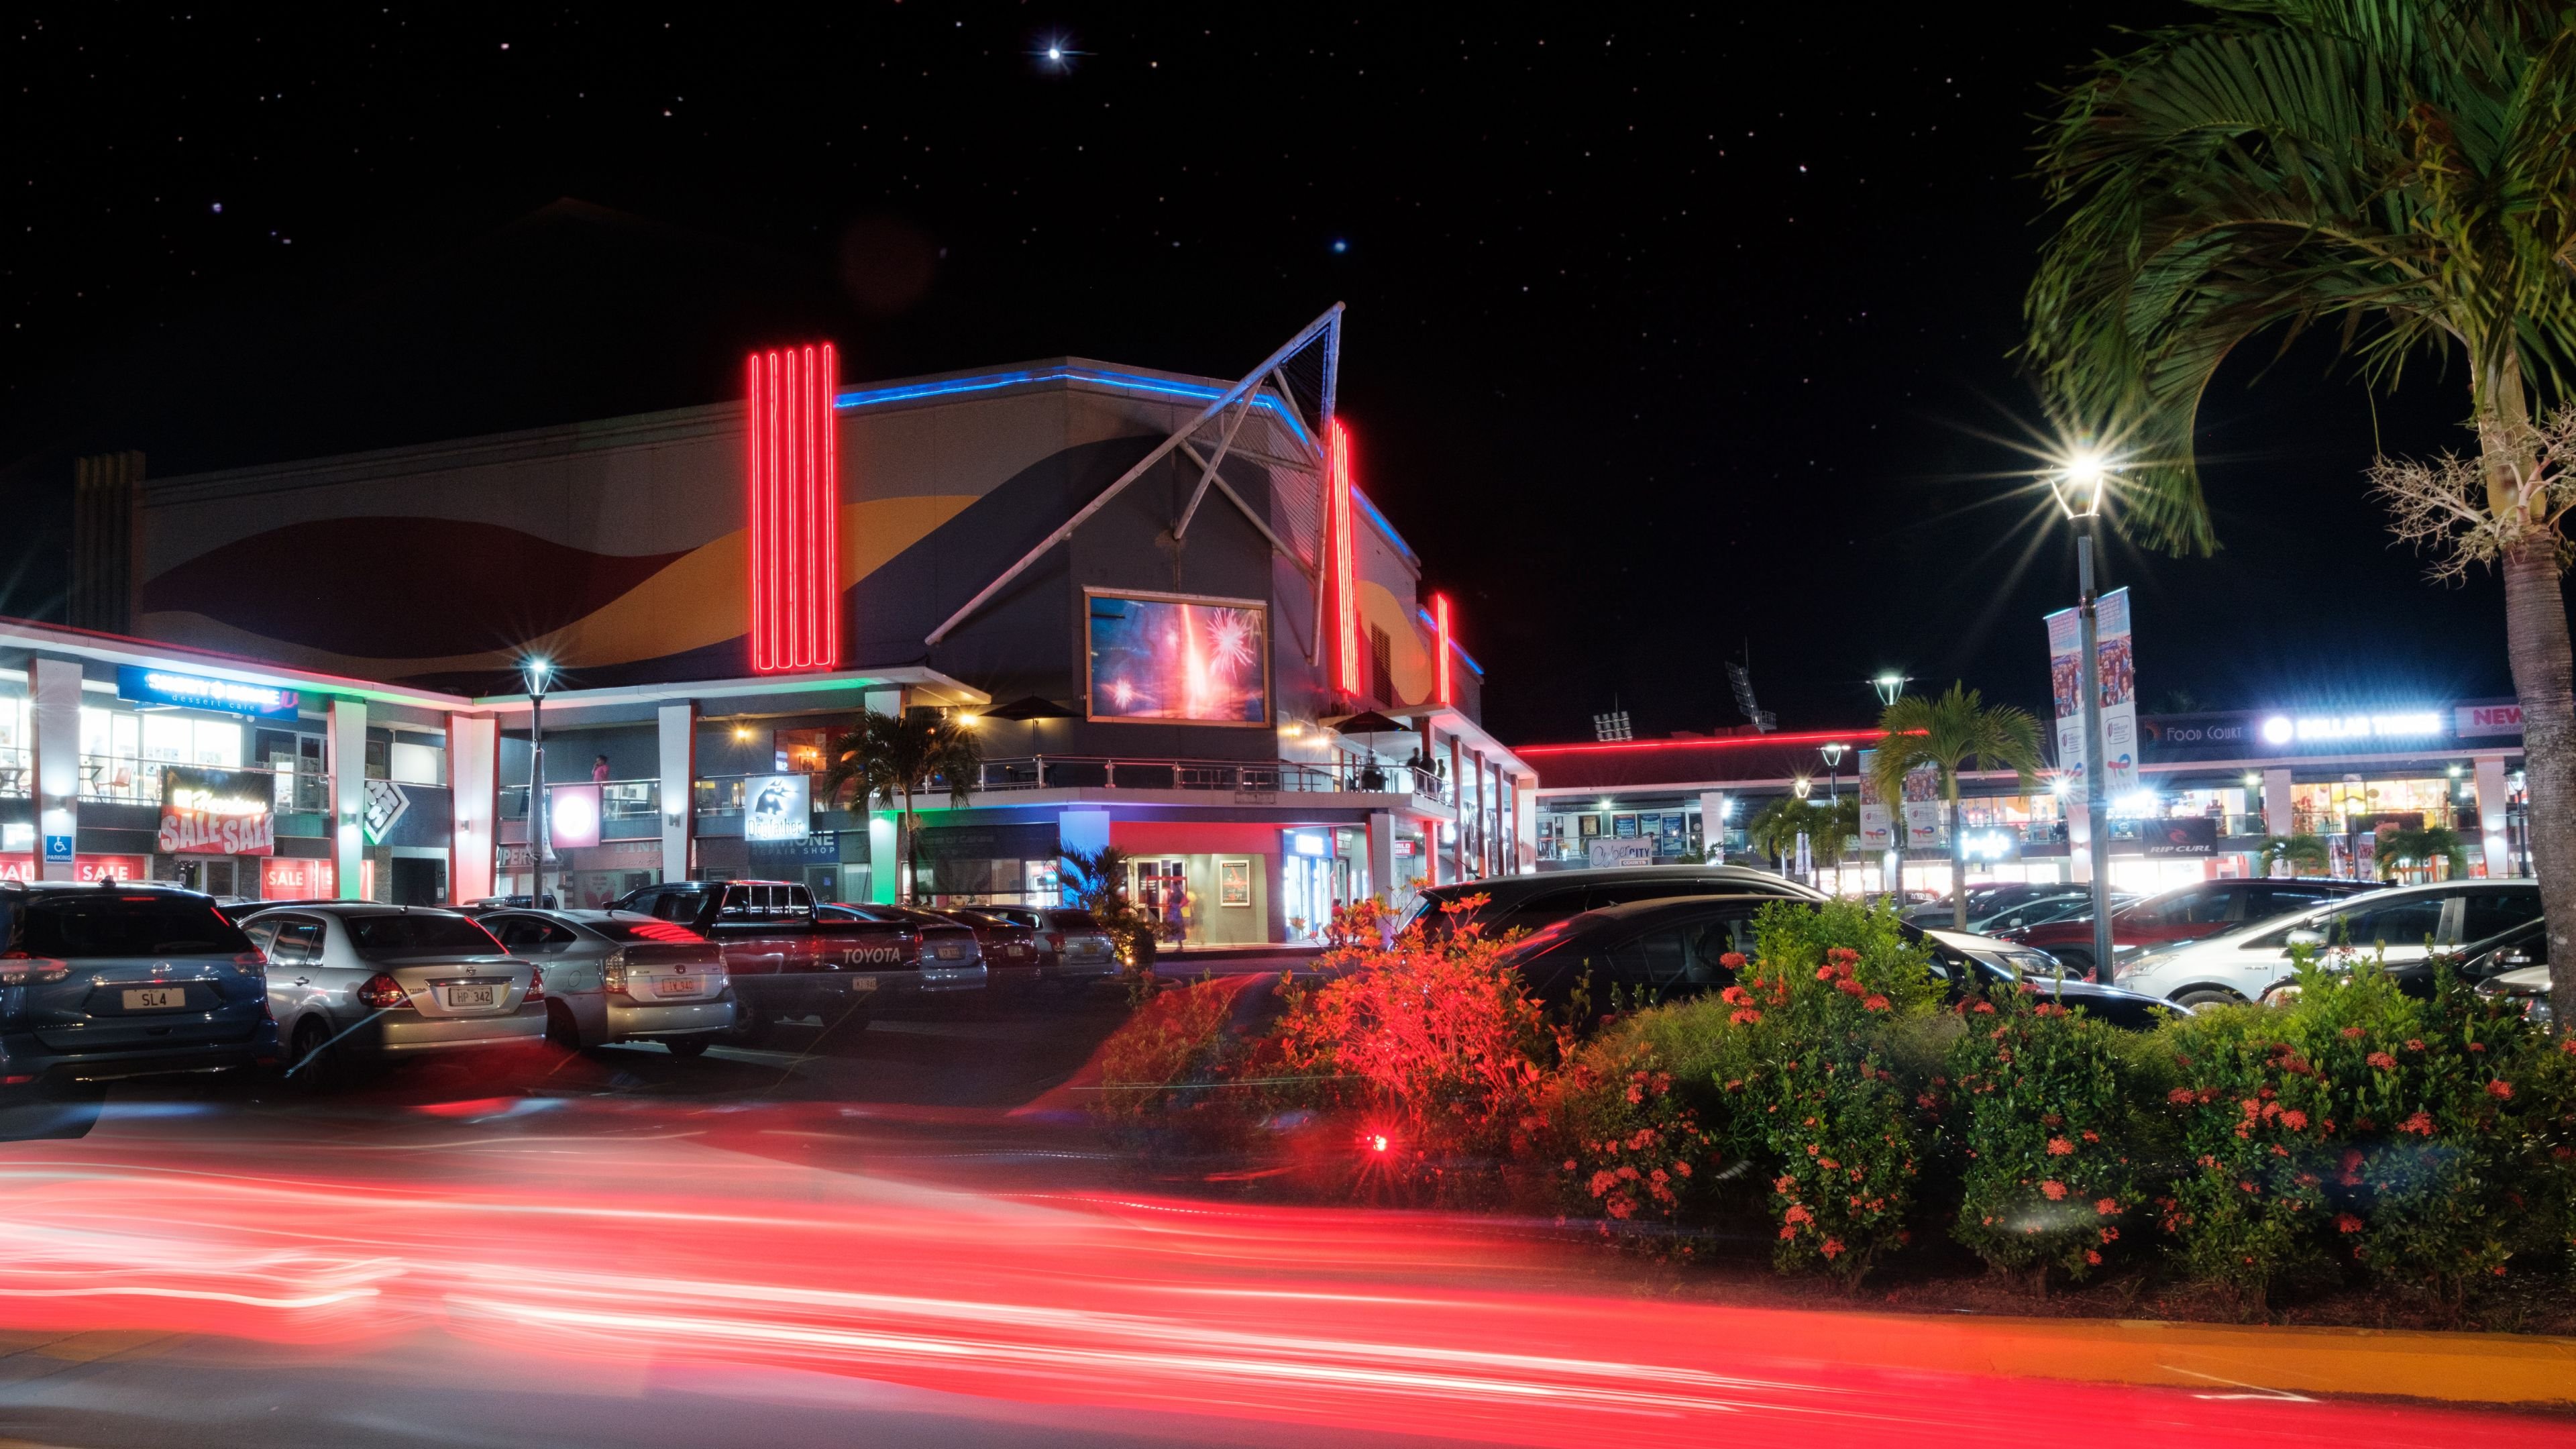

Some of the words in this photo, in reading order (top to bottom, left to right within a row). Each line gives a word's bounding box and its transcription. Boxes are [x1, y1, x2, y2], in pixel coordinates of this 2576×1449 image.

[172, 694, 221, 707] dessert
[229, 702, 256, 711] cafe
[2167, 727, 2202, 741] FOOD
[2206, 726, 2243, 739] COURT
[160, 812, 221, 851] SALE
[748, 818, 802, 839] Dogfather
[83, 865, 128, 881] SALE
[268, 871, 303, 886] SALE
[843, 947, 901, 965] TOYOTA
[458, 992, 469, 1003] HP
[474, 991, 490, 1002] 342
